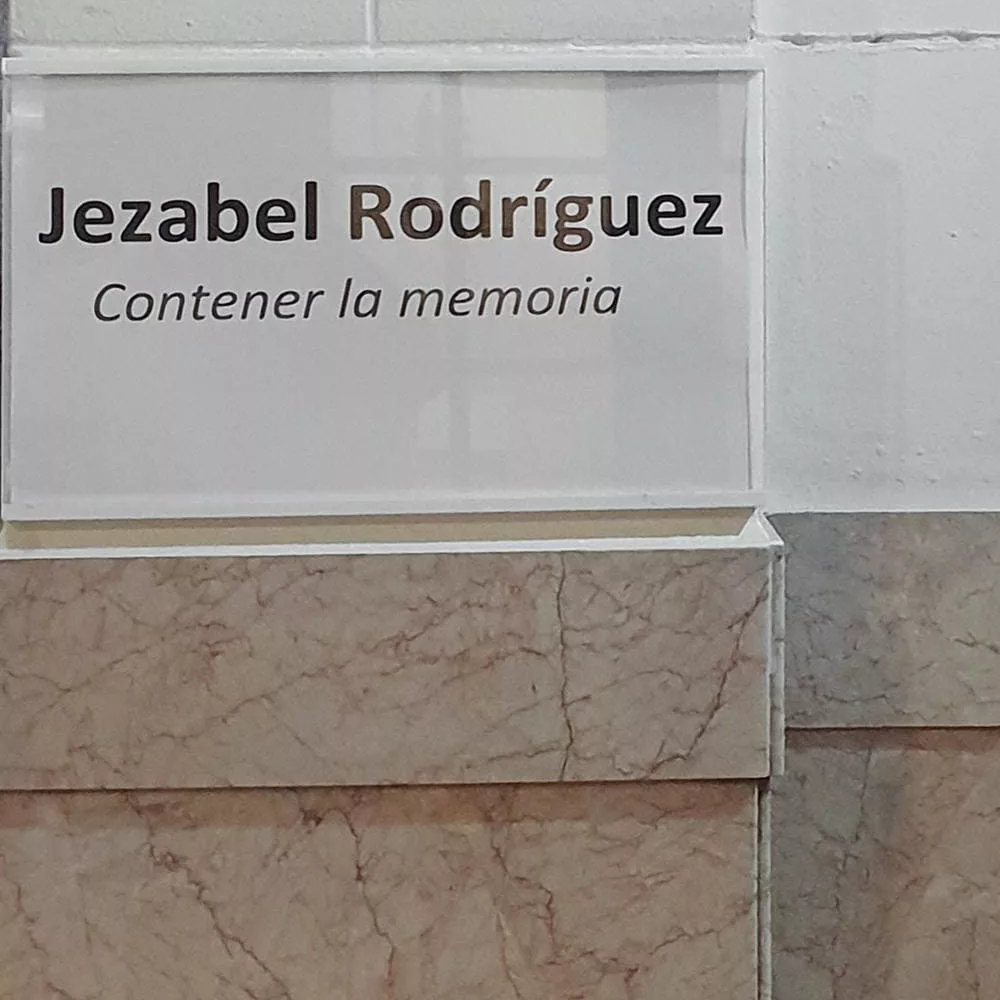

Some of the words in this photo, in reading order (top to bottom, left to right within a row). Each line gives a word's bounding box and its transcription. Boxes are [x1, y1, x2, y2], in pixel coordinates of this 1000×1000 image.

[38, 180, 318, 245] Jezabel
[349, 177, 724, 253] Rodríguez
[93, 283, 325, 322] Contener
[338, 277, 382, 319] la
[399, 276, 622, 318] memoria
